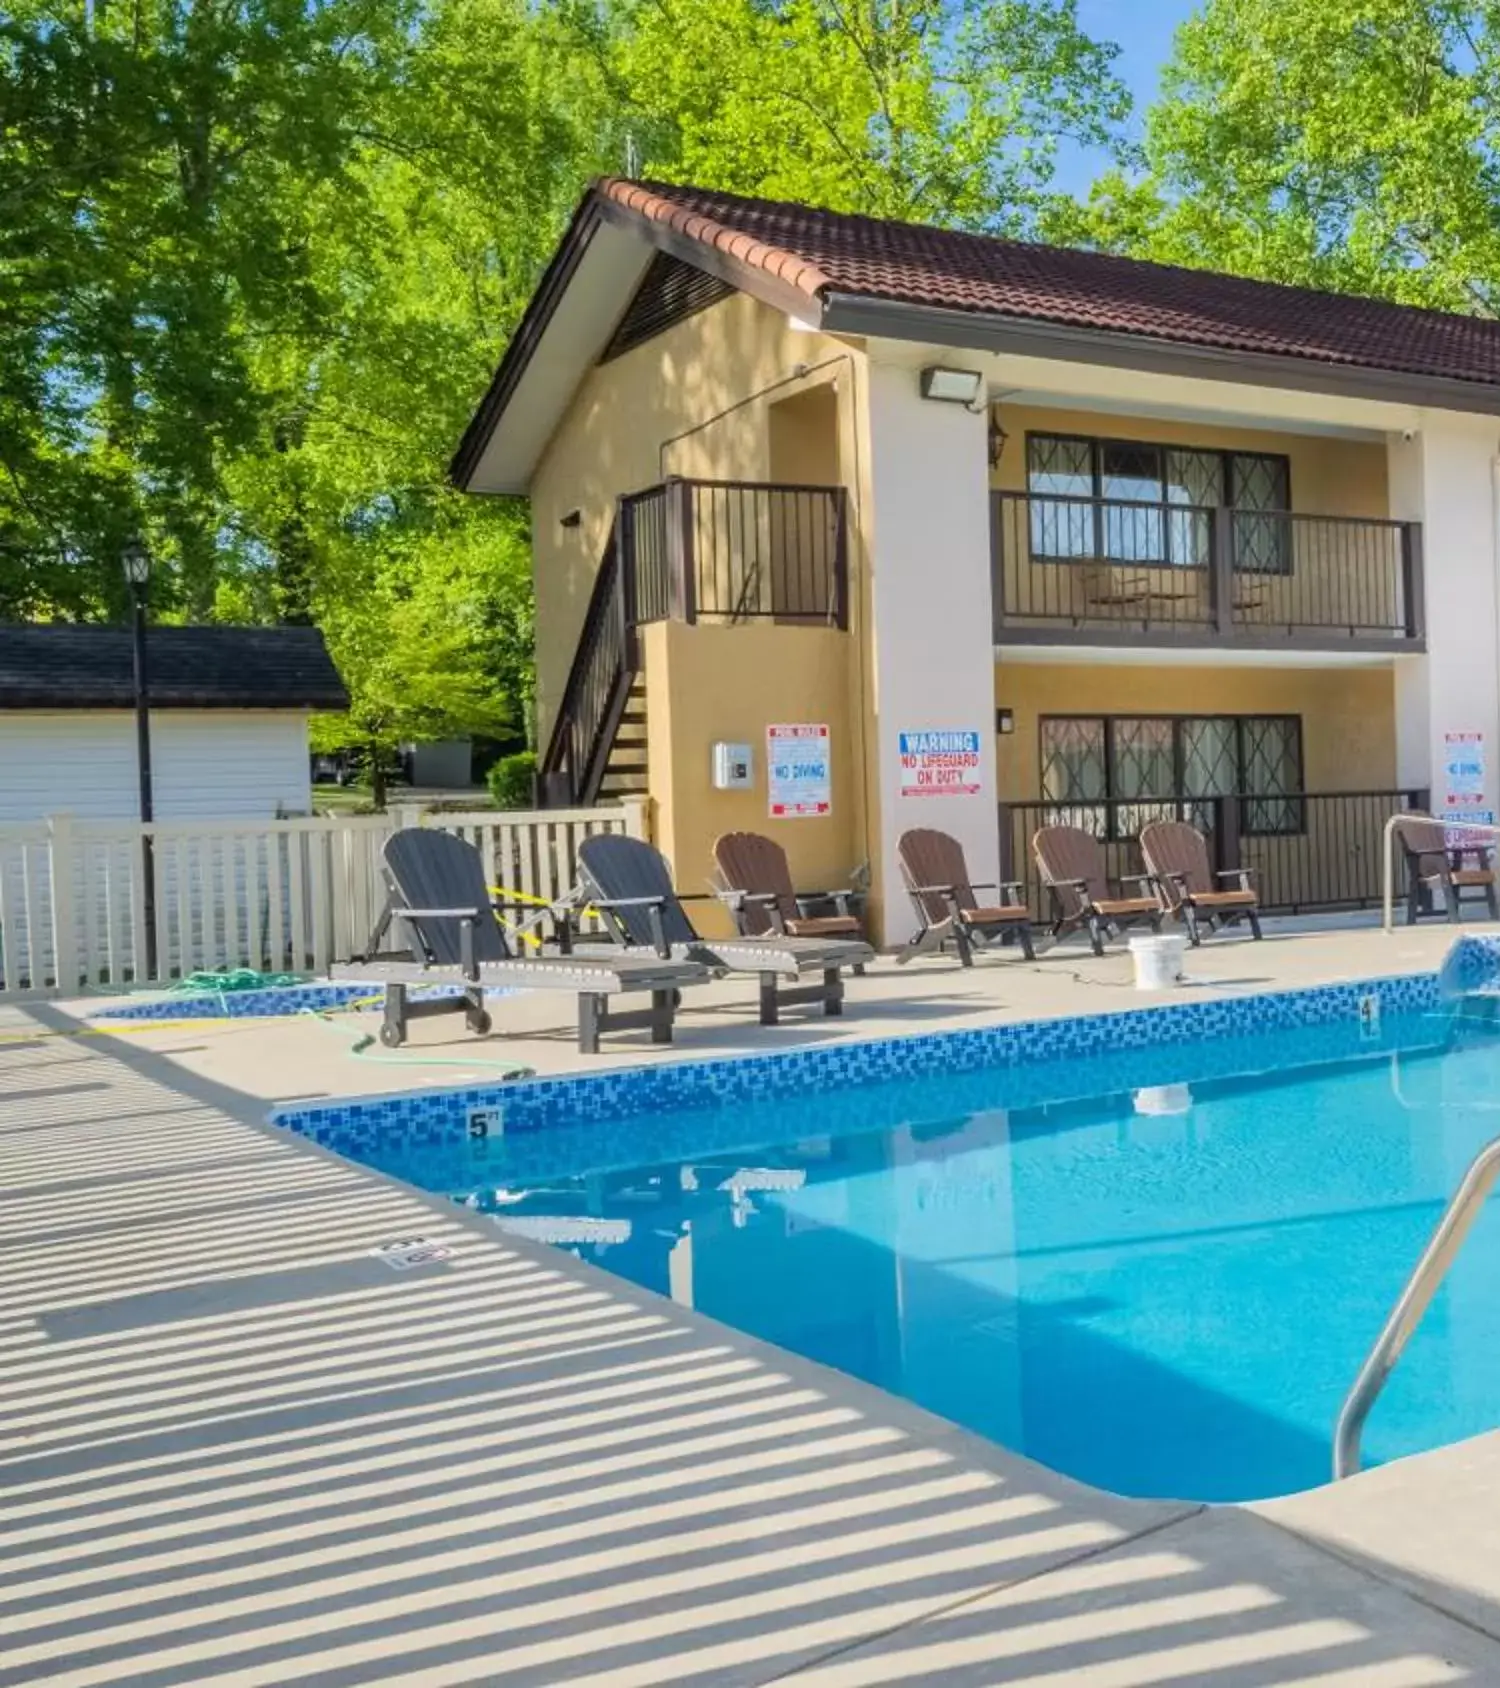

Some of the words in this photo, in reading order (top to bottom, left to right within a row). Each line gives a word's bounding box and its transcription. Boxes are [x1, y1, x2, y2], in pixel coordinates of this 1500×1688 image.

[906, 733, 974, 752] WARNING
[901, 754, 917, 768] NO
[921, 753, 979, 768] LIFEGUARD
[774, 764, 789, 778] NO
[792, 764, 826, 778] DIVING
[917, 770, 933, 784] ON
[937, 769, 964, 784] DUTY
[470, 1113, 488, 1138] 5
